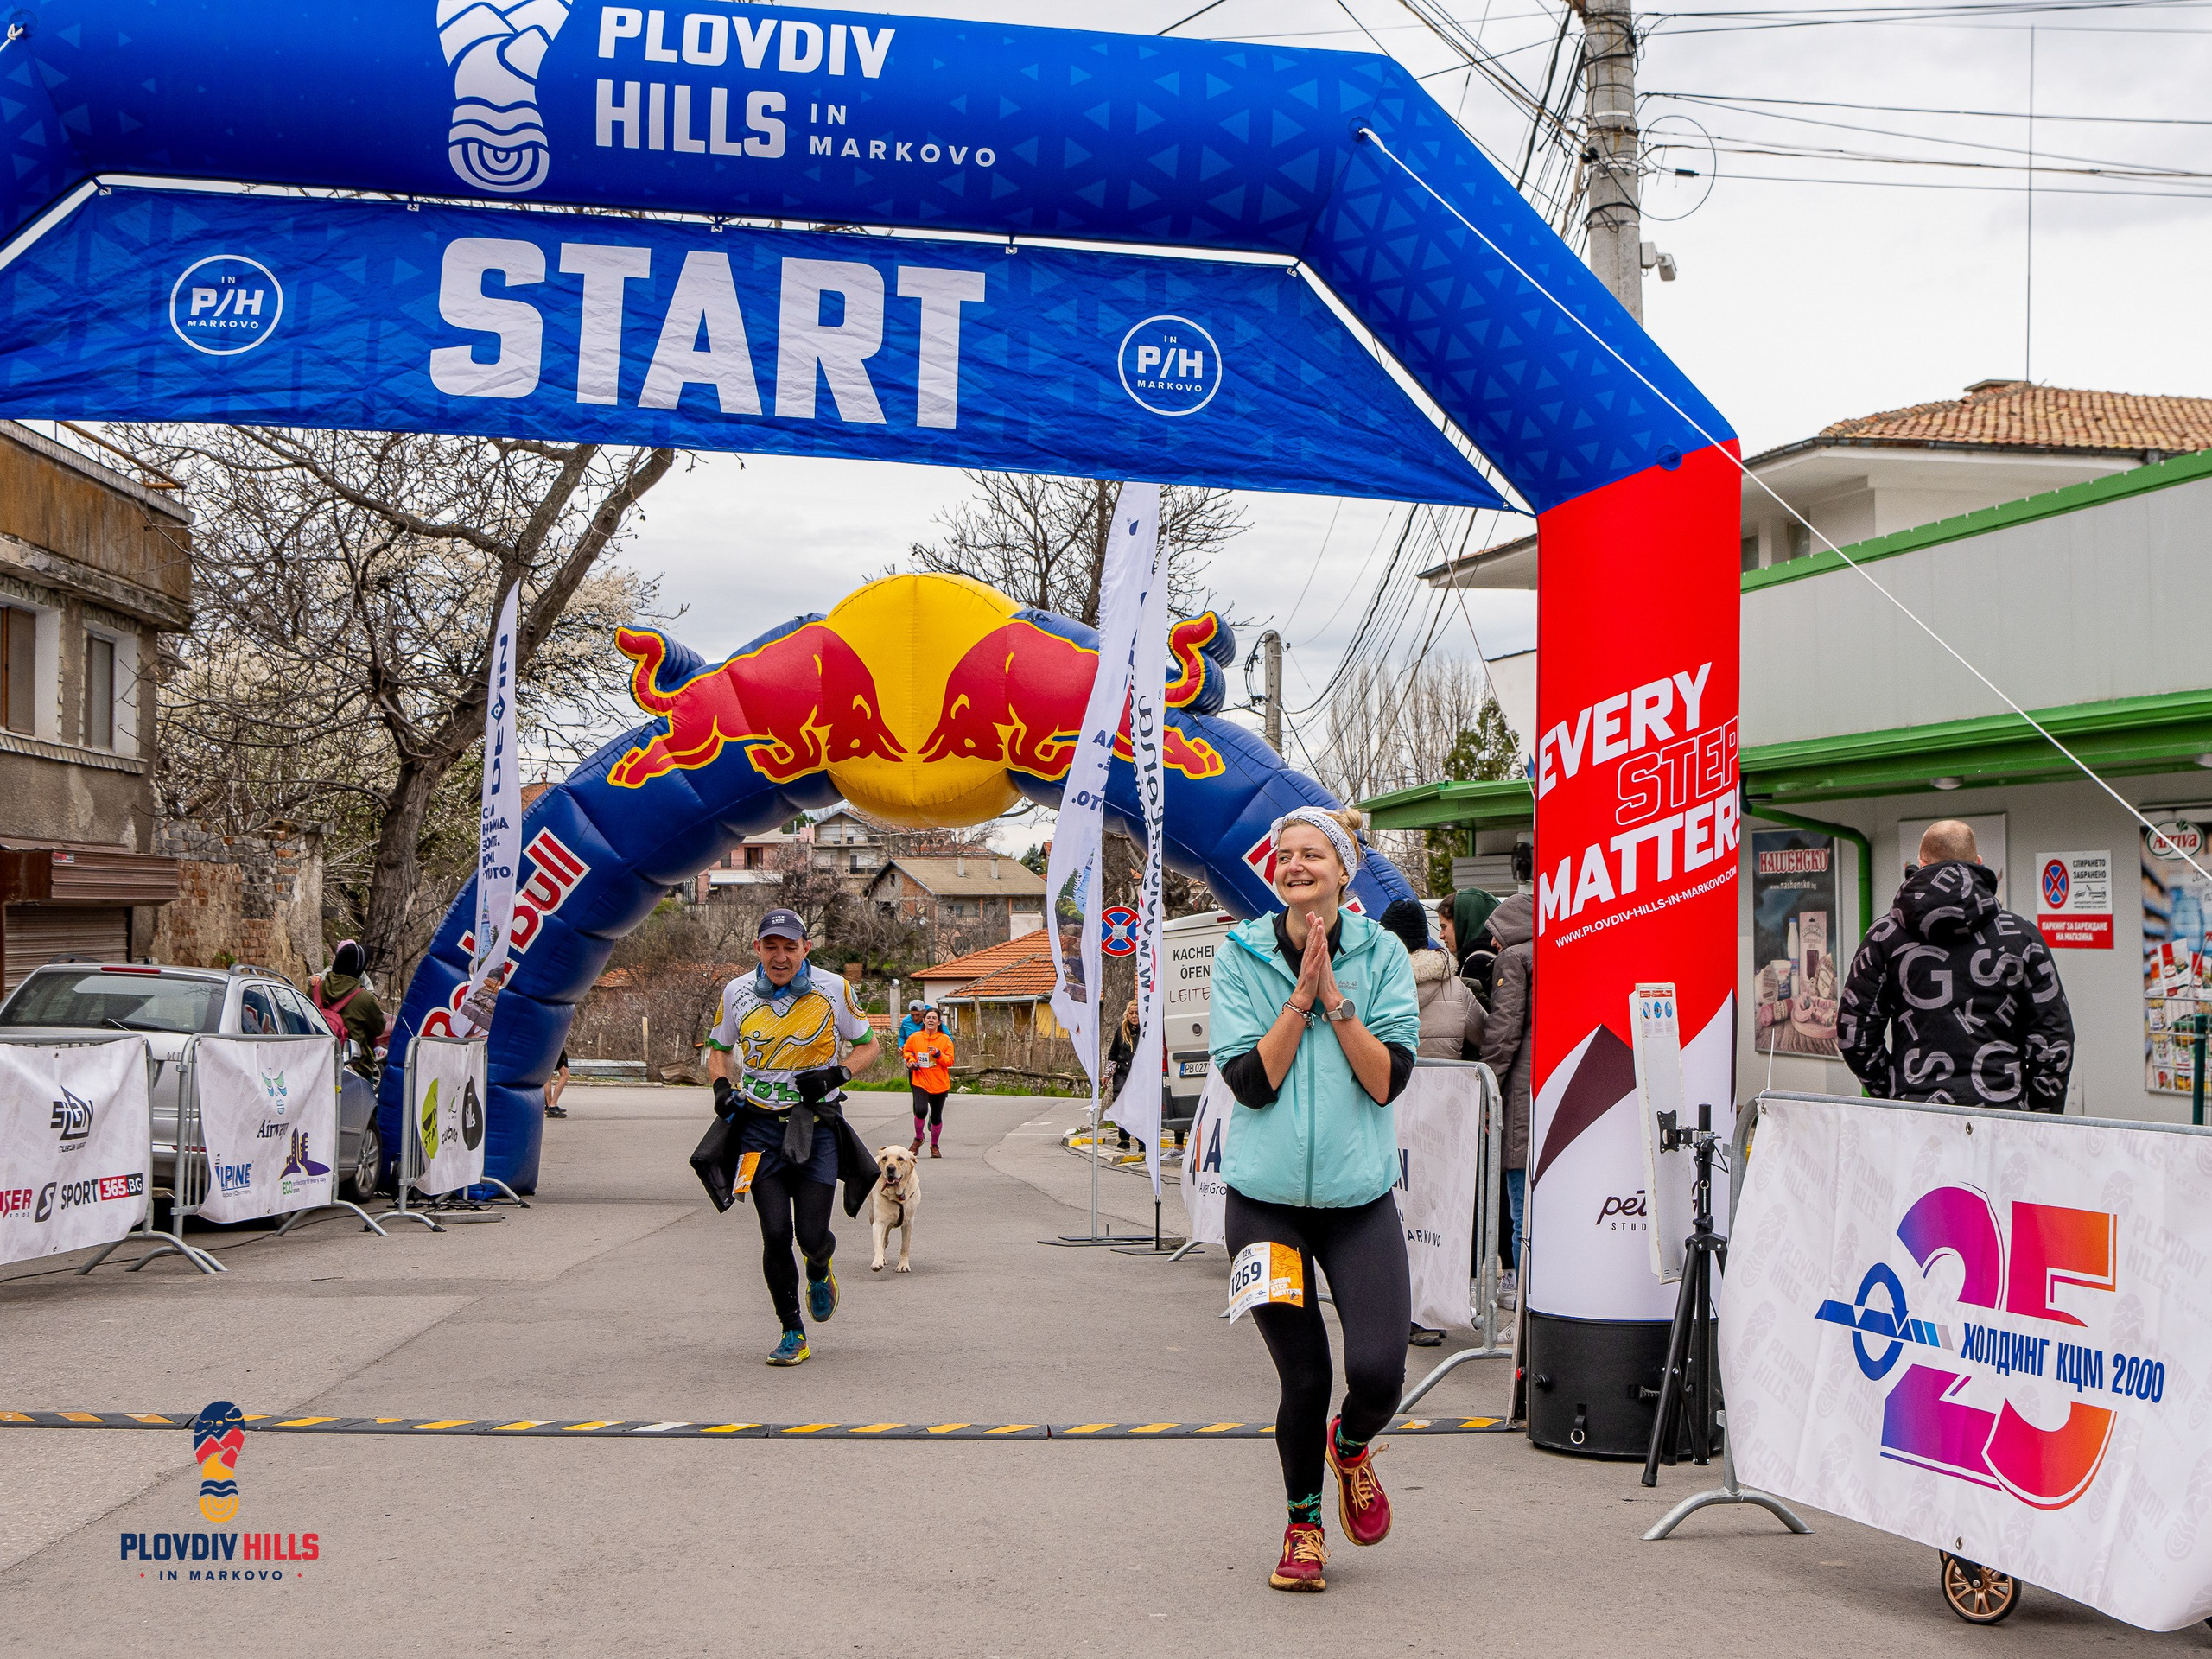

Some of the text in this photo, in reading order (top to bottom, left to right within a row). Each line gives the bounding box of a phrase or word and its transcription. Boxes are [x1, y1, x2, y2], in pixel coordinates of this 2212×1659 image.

[599, 7, 895, 78] PLOVDIV
[596, 79, 785, 158] HILLS
[810, 104, 845, 125] IN
[810, 136, 995, 168] MARKOVO
[190, 288, 264, 317] P/H
[187, 320, 260, 329] MARKOVO
[430, 238, 985, 429] START
[1138, 346, 1203, 378] P/H
[1137, 380, 1203, 392] MARKOVO
[1539, 662, 1712, 800] EVERY
[1616, 715, 1738, 825] STEP
[1759, 849, 1829, 874] НАШЕНСКО
[2073, 859, 2106, 868] СПИРАНЕТО
[2073, 870, 2107, 879] ЗАБРАНЕНО
[1555, 865, 1737, 948] WWW.PLOVDIV-HILLS-IN-MARKOVO.COM
[2042, 922, 2108, 931] ПАРКИНГ ЗА ЗАРЕЖДАНЕ
[2056, 932, 2094, 941] НА МАГАЗИНА
[1180, 964, 1210, 979] ÖFEN
[1210, 1182, 1227, 1196] Gro
[1408, 1228, 1441, 1248] ARKOVO
[1611, 1222, 1647, 1231] STUD
[1231, 1261, 1262, 1296] 1269
[1961, 1322, 2050, 1376] ХОЛДИНГ
[2056, 1342, 2104, 1393] КЦМ
[2112, 1353, 2165, 1403] 2000
